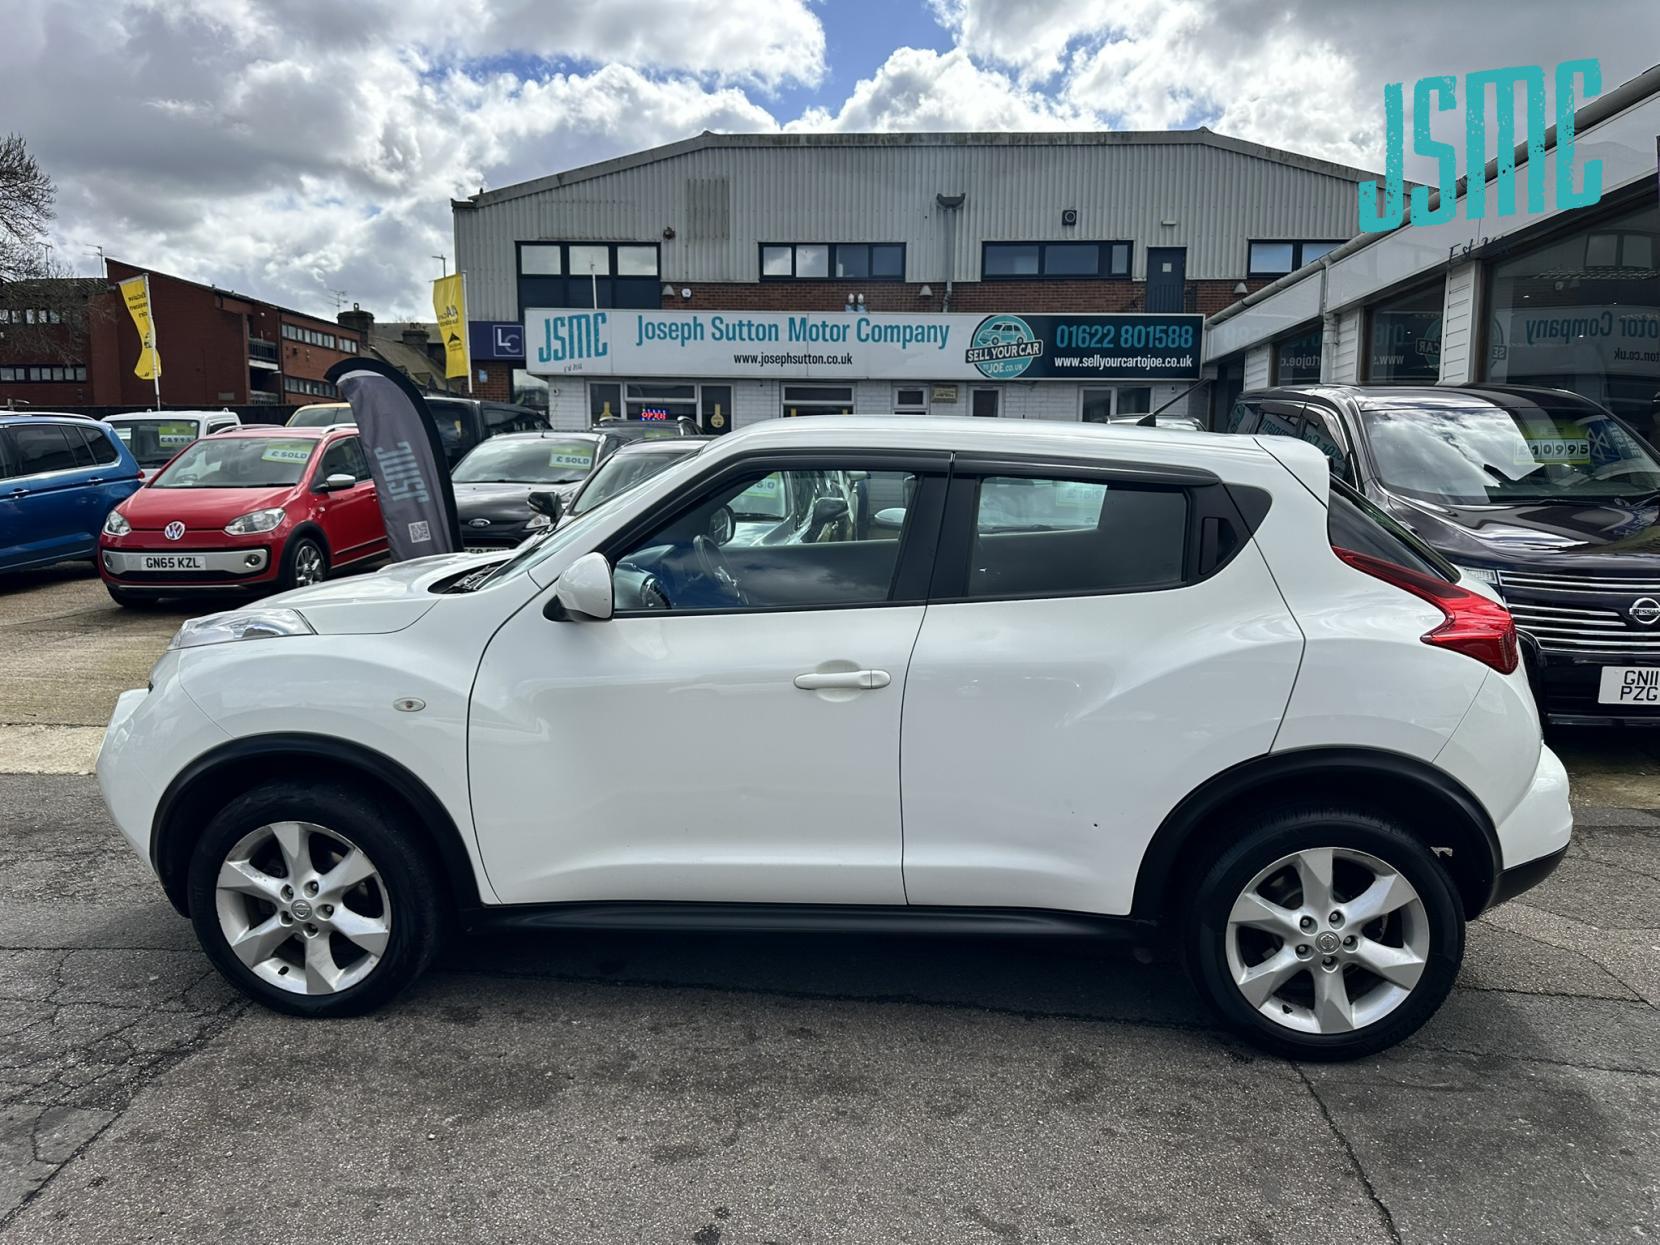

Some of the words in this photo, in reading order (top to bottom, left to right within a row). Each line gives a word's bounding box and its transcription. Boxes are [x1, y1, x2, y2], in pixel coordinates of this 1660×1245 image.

[538, 312, 608, 363] JSMC
[636, 315, 704, 347] Joseph
[711, 316, 779, 342] Sutton
[788, 317, 850, 343] Motor
[856, 317, 950, 349] Company
[1056, 324, 1114, 348] 01622
[1120, 325, 1193, 349] 801588
[733, 352, 853, 367] www.josephsutton.co.uk
[967, 349, 990, 362] SELL
[991, 345, 1018, 359] YOUR
[1019, 343, 1039, 355] CAR
[1054, 355, 1192, 370] www.sellyourcartojoe.co.uk
[280, 451, 308, 459] SOLD
[565, 456, 590, 465] SOLD
[374, 440, 430, 504] JSMC
[146, 557, 175, 568] GN65
[178, 556, 200, 568] KZL
[1619, 685, 1658, 701] PZG
